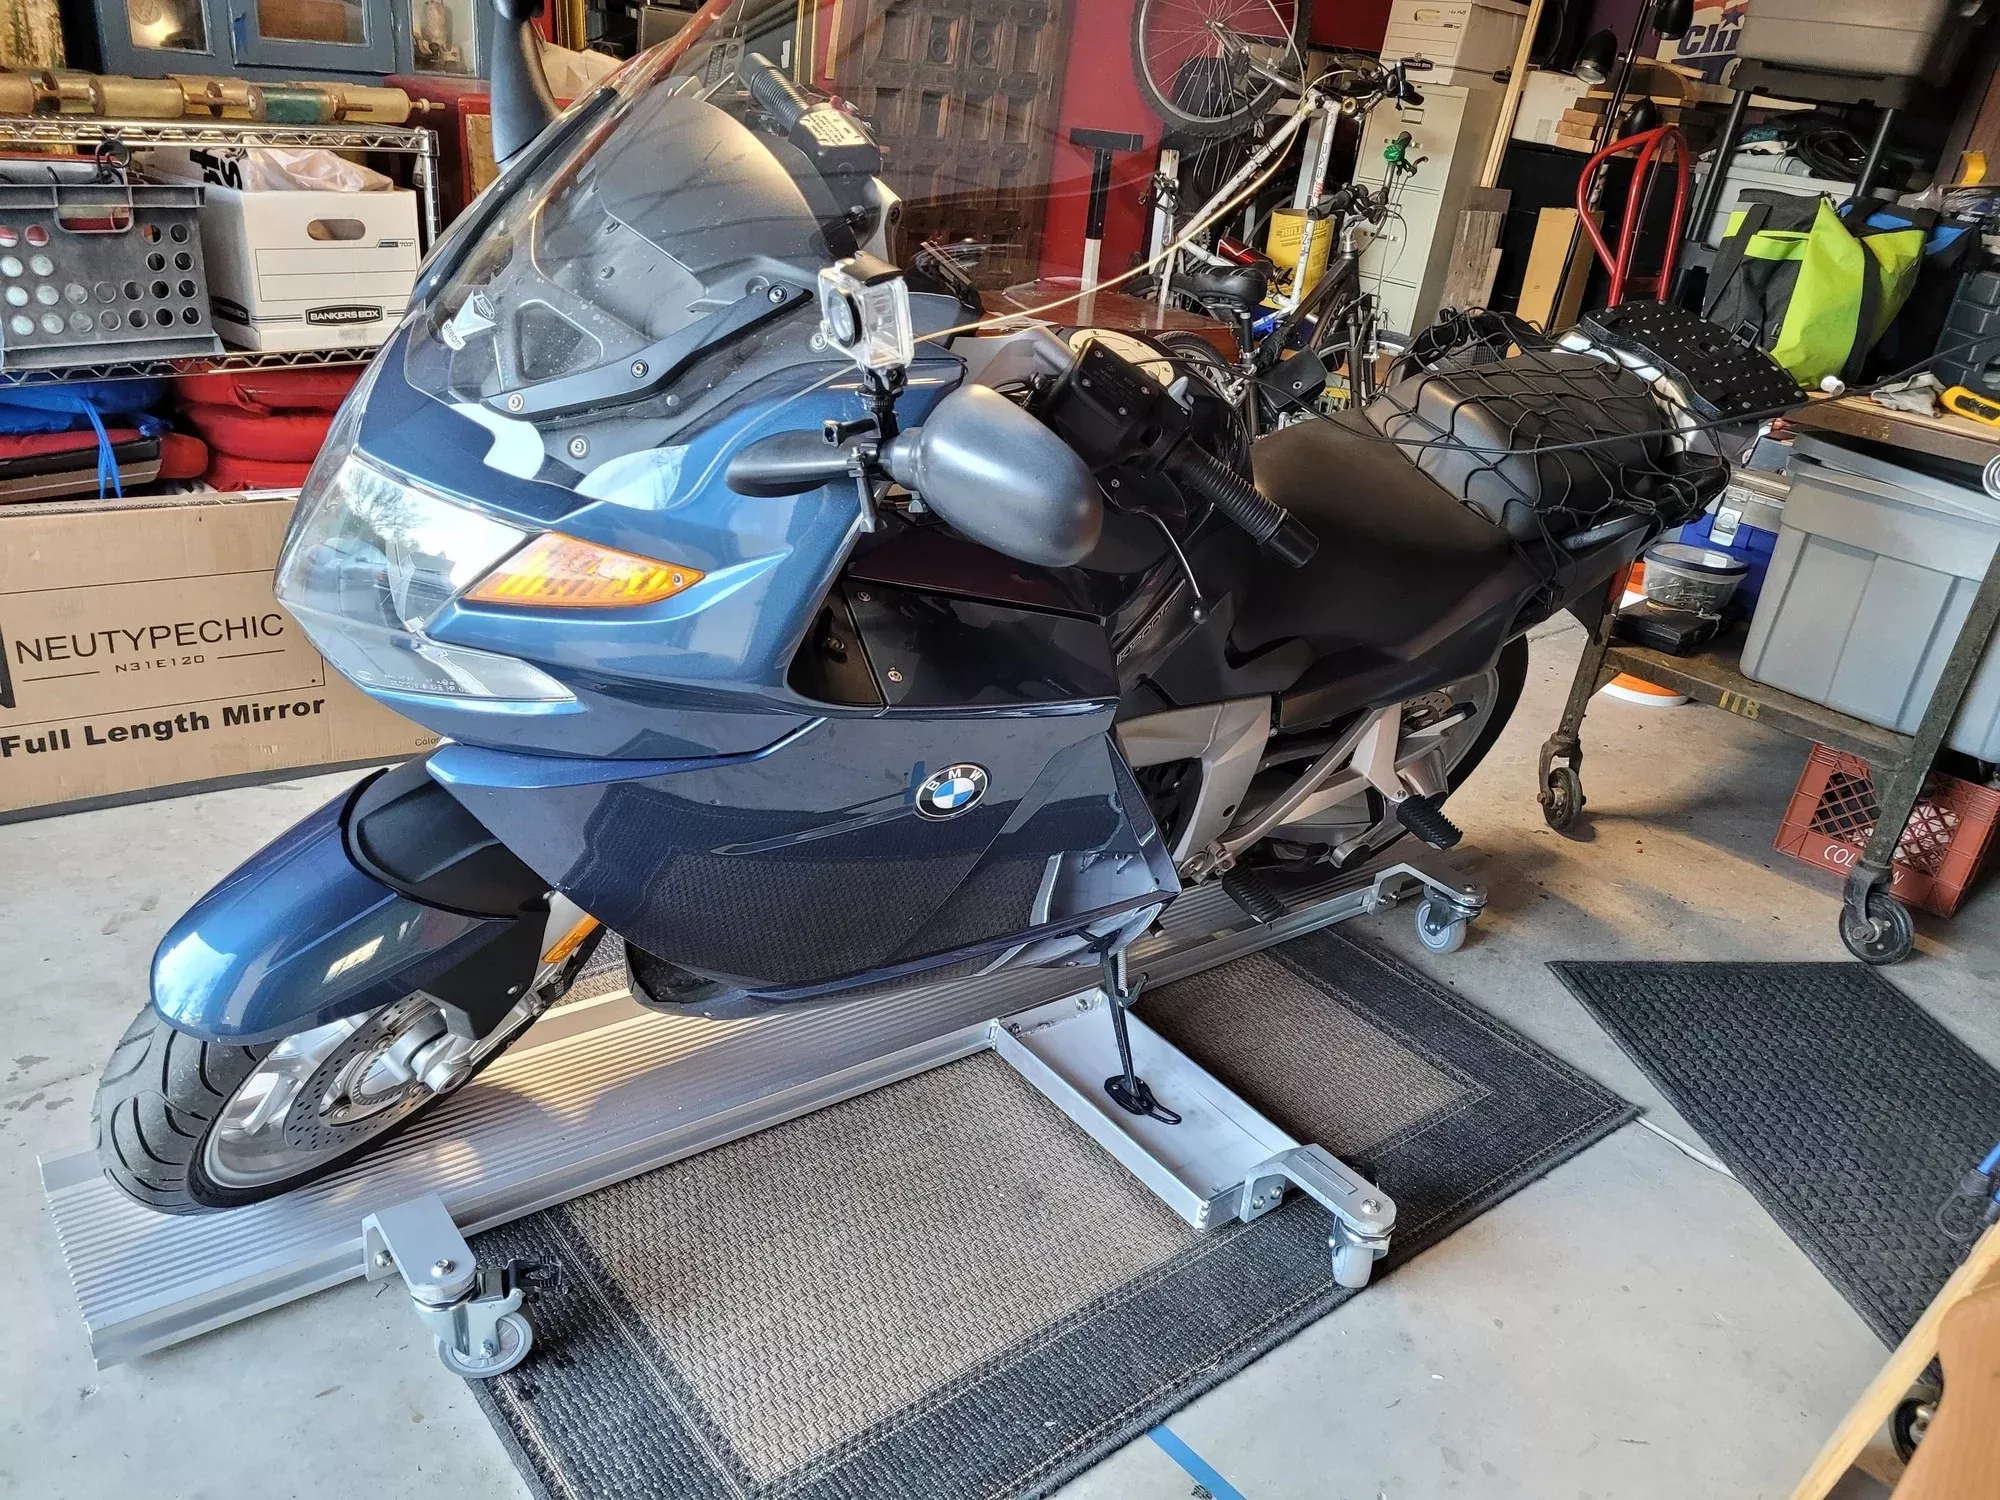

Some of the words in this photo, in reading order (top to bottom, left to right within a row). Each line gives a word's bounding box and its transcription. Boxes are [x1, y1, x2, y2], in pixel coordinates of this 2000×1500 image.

[310, 310, 358, 321] BANKERS
[358, 309, 379, 319] BOX
[443, 323, 462, 349] stream
[15, 613, 285, 664] NEUTYPECHIC
[115, 654, 206, 673] N31E120
[1719, 690, 1761, 720] 118
[1, 728, 71, 758] Full
[84, 711, 210, 742] Length
[222, 698, 326, 727] Mirror
[926, 768, 983, 792] BMW
